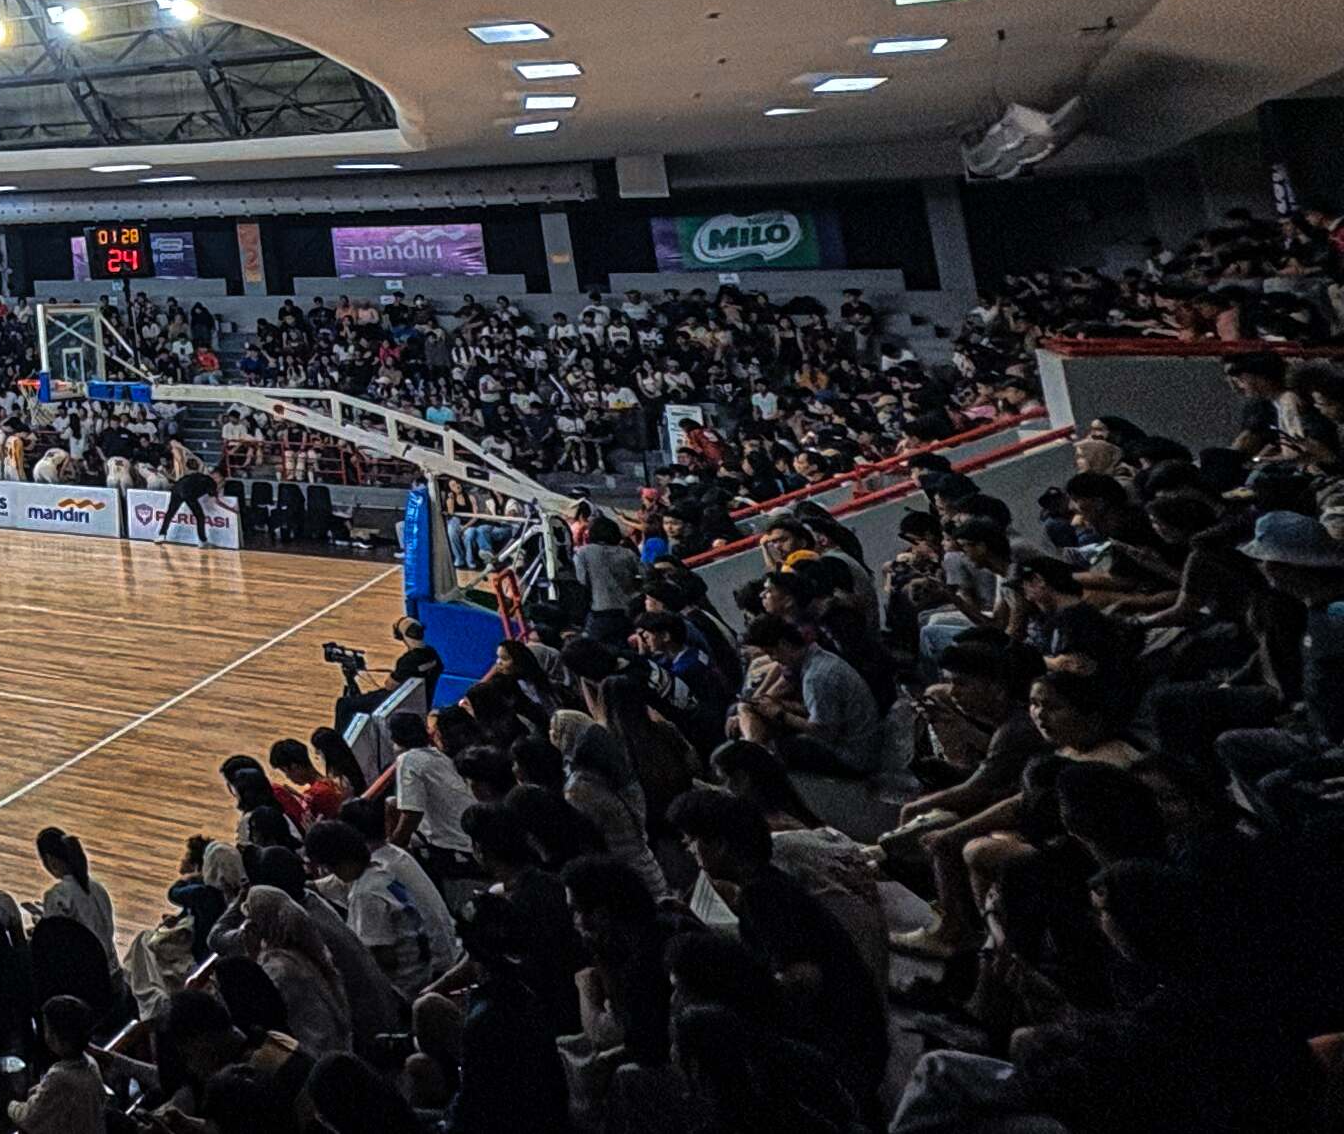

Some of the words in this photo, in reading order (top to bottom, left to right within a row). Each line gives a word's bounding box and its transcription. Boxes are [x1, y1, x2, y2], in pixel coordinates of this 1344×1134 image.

[708, 223, 791, 251] MILO
[107, 249, 138, 272] 24
[344, 241, 443, 263] mandiri
[28, 505, 90, 524] mandiri
